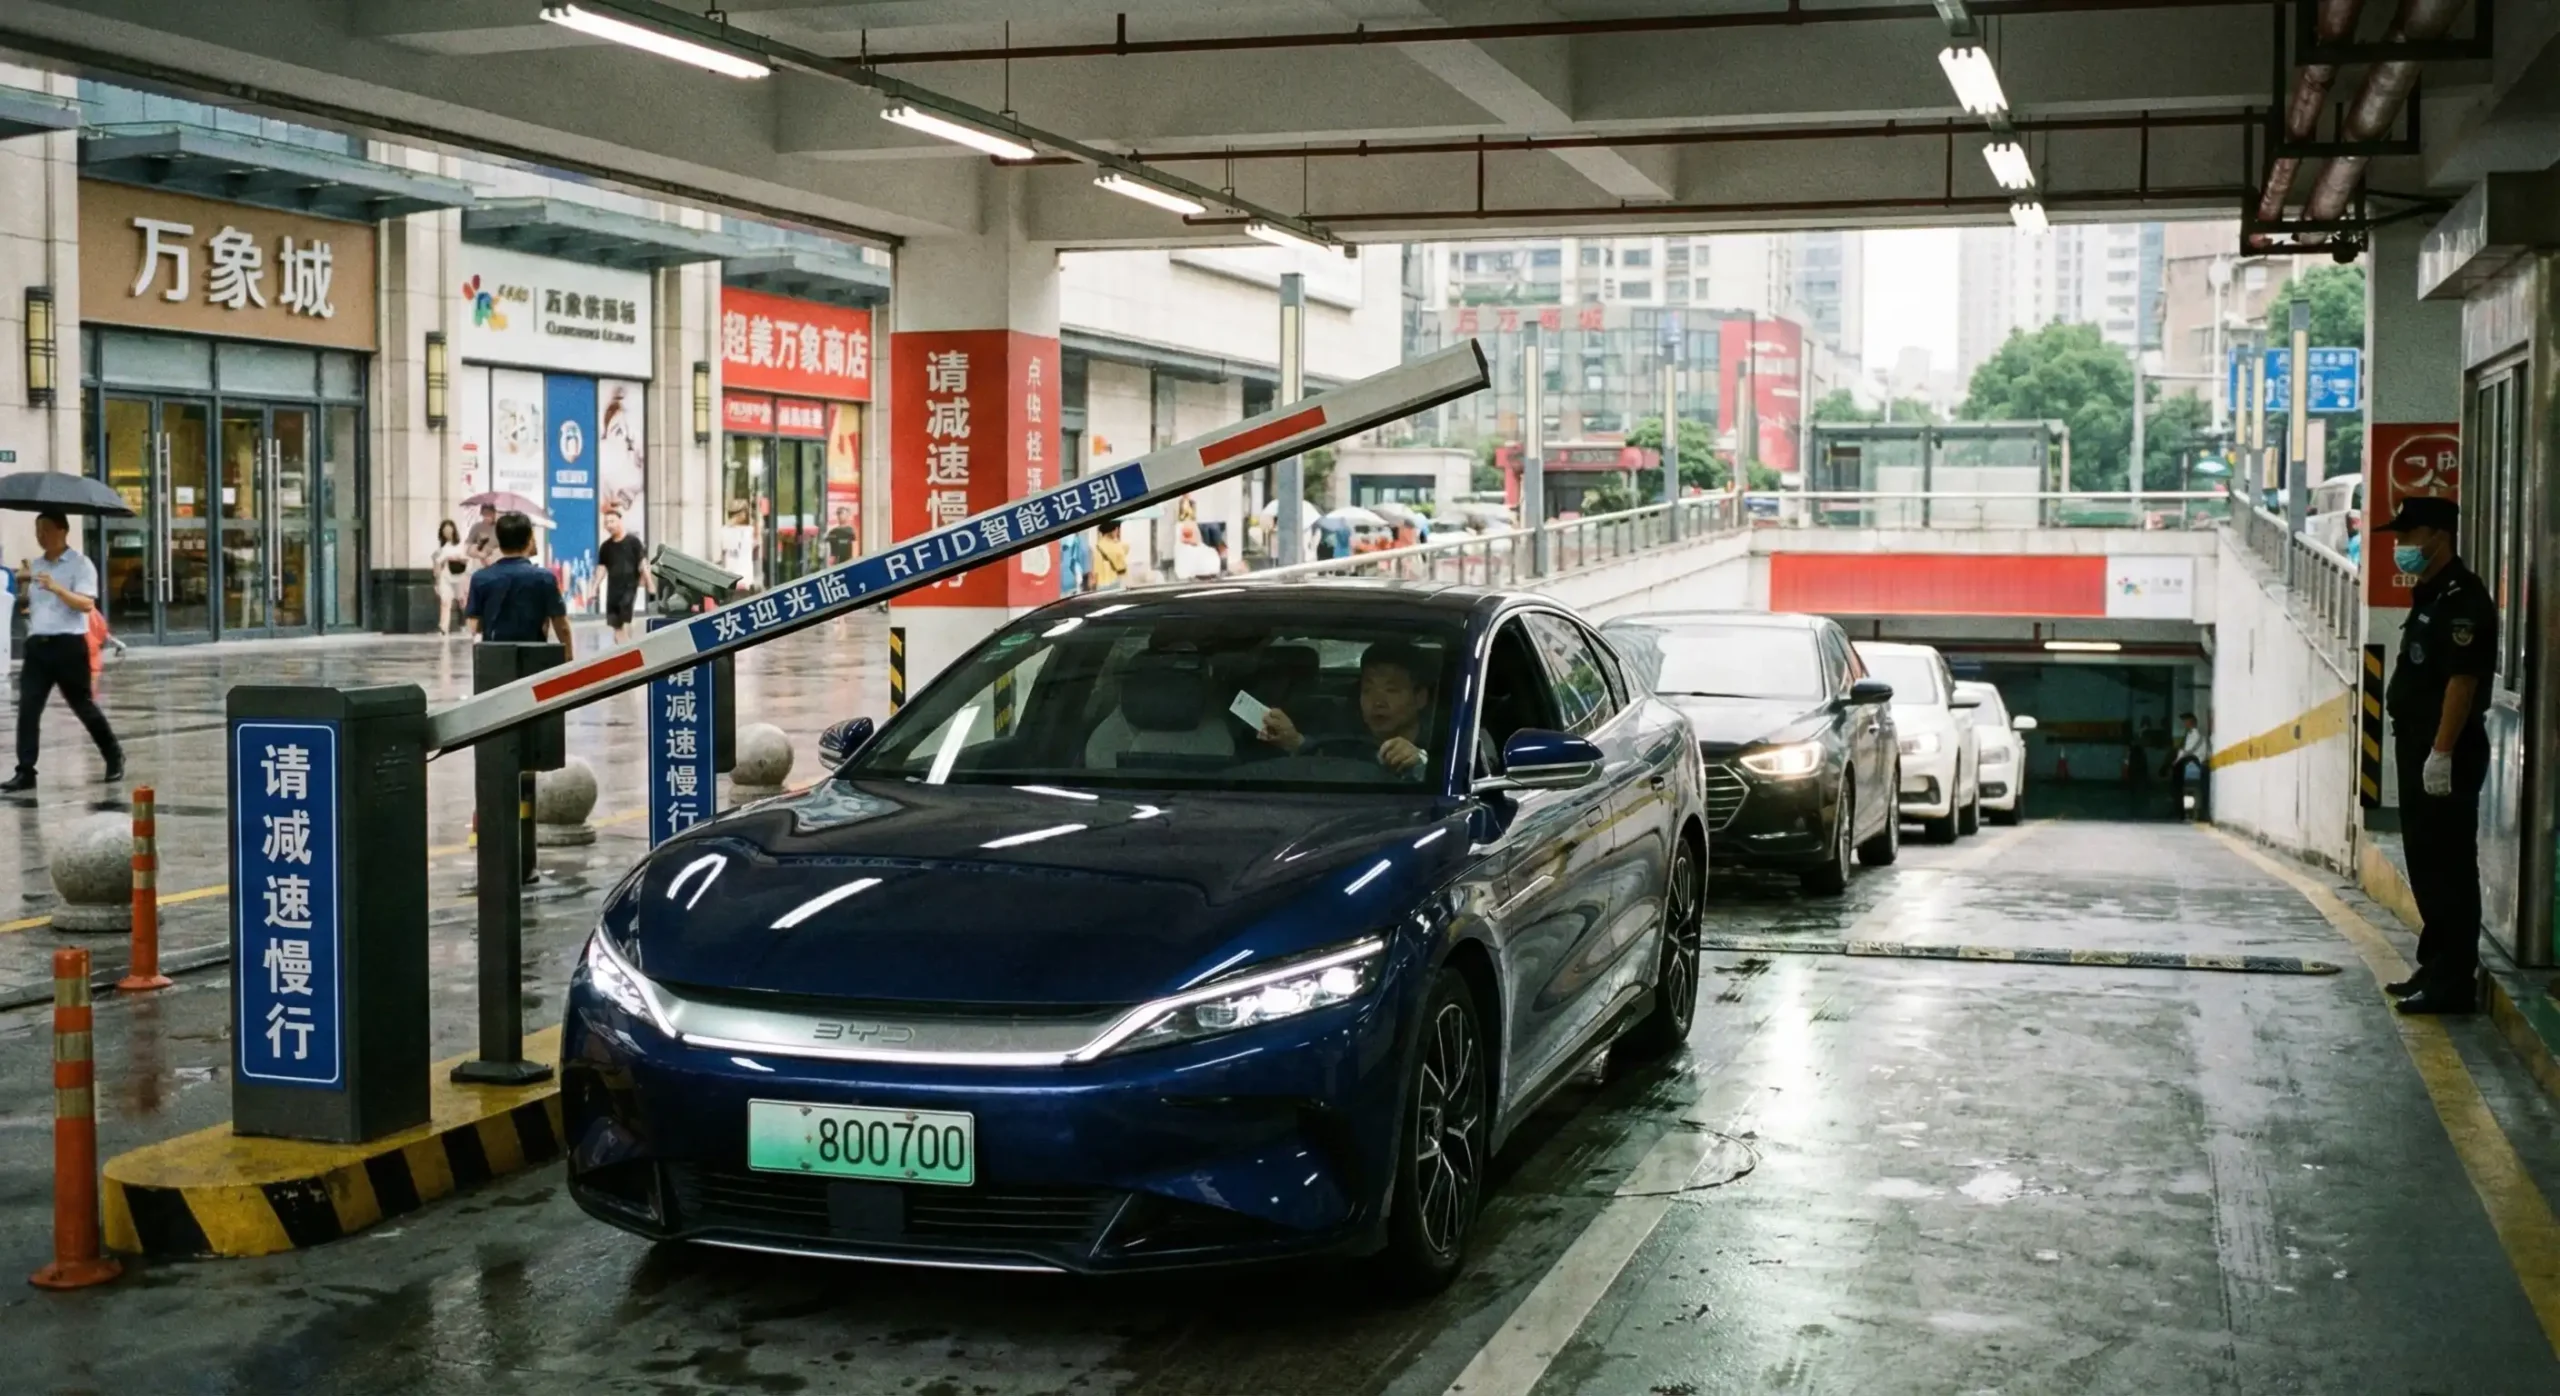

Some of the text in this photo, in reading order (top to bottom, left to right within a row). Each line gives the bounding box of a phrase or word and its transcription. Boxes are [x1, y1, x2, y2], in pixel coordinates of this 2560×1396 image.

[132, 216, 334, 319] 万象城
[926, 350, 971, 588] 请减速慢
[261, 744, 315, 1060] 请减速慢行
[813, 1022, 915, 1043] BYD
[819, 1118, 965, 1171] 800700
